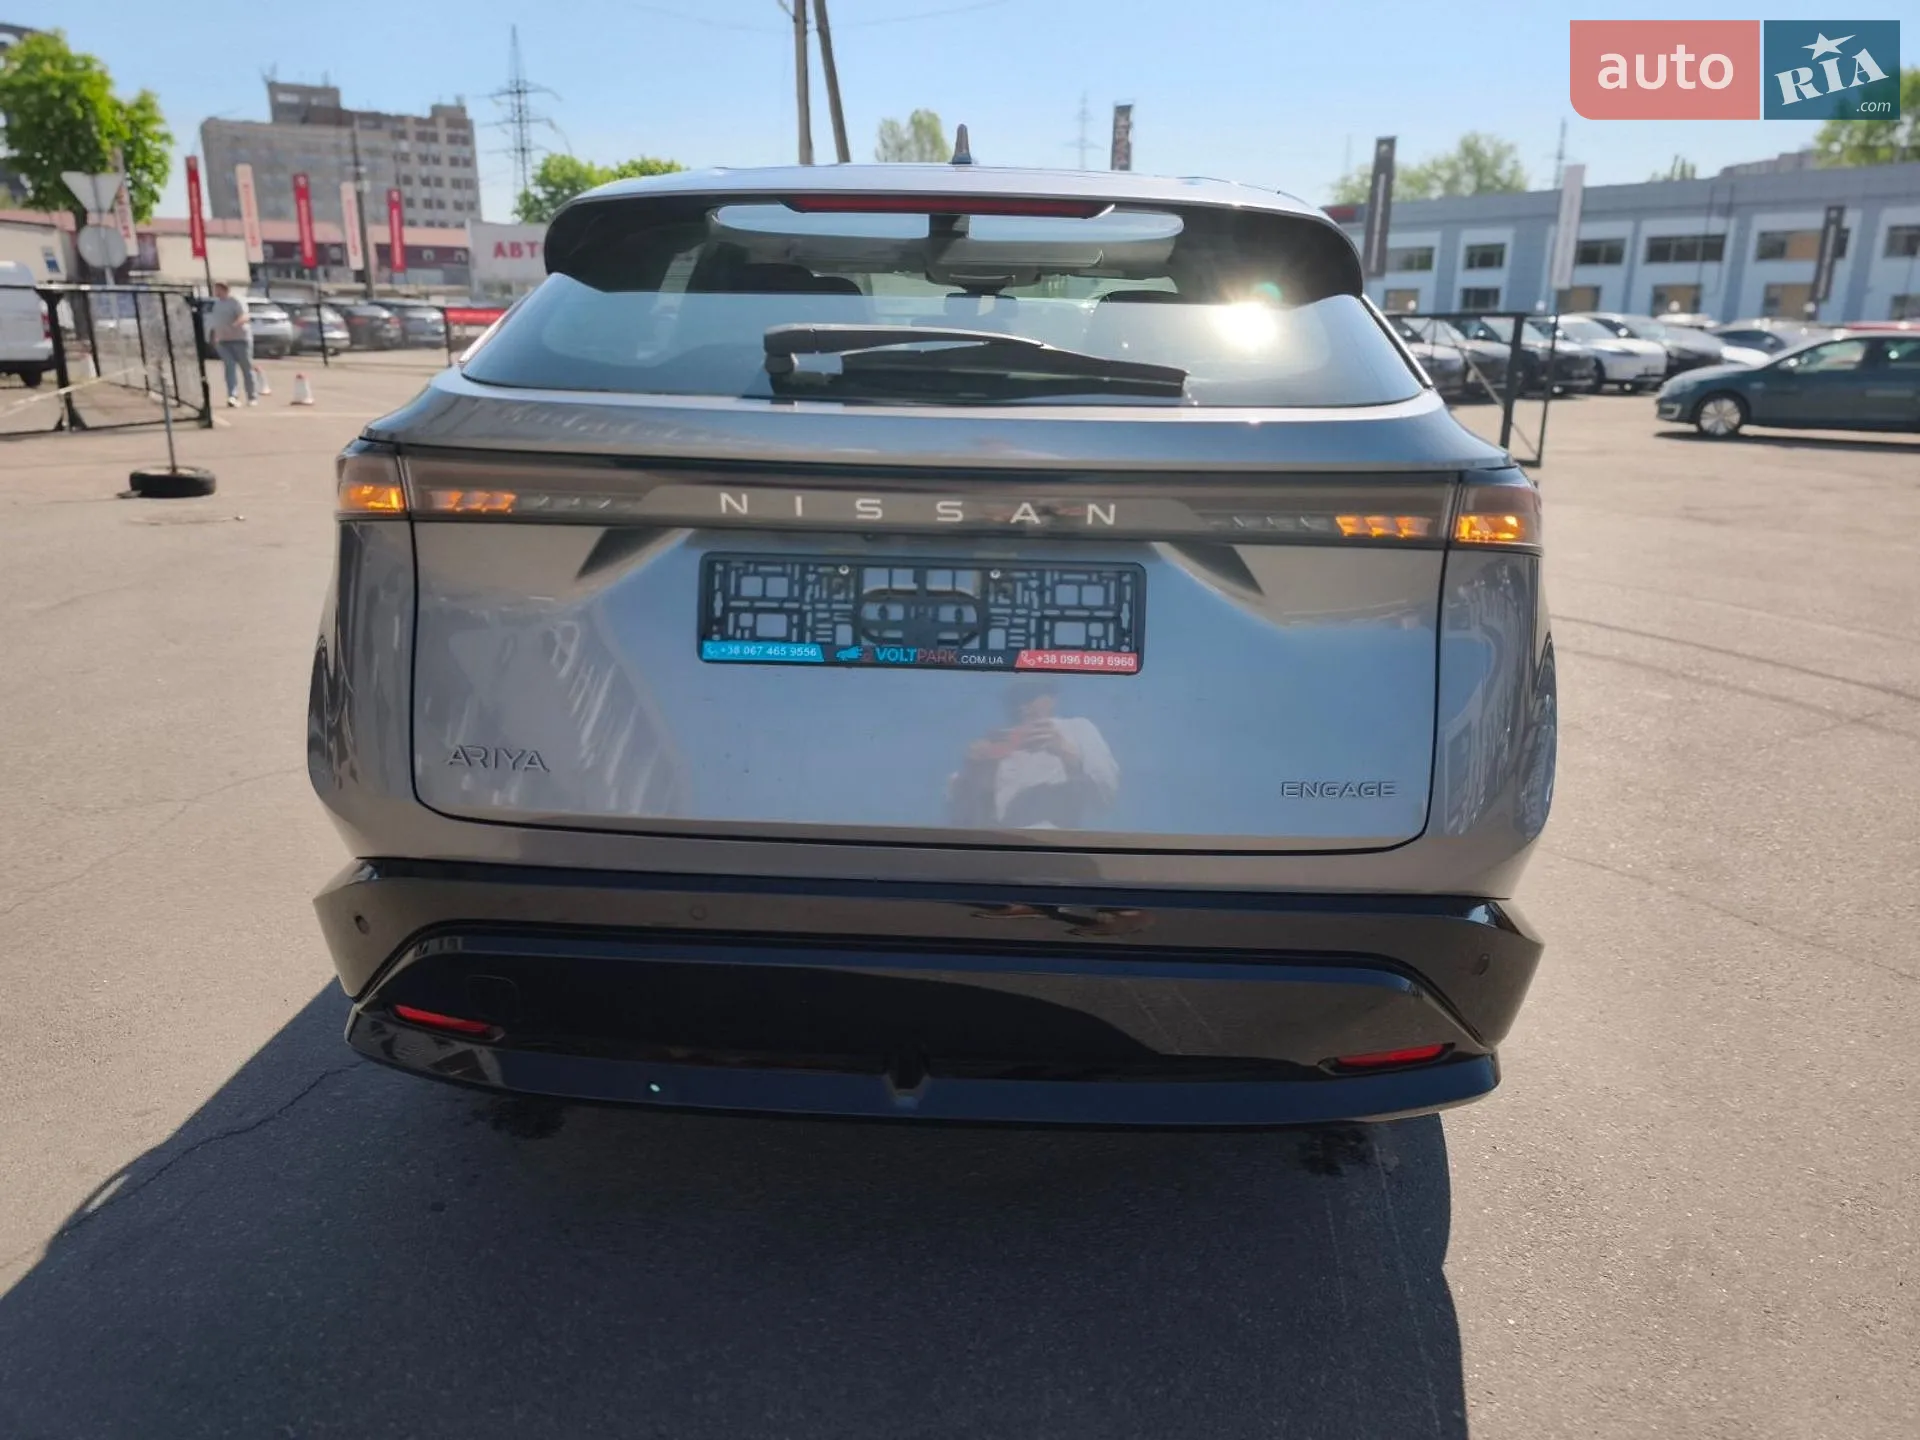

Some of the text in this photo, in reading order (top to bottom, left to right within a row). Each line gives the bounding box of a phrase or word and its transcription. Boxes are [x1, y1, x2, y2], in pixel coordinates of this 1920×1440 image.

[493, 240, 546, 260] АВТ
[719, 491, 1117, 526] NISSAN
[743, 645, 764, 656] 067
[767, 646, 787, 657] 465
[1035, 653, 1057, 665] +38
[448, 744, 551, 773] ARIYA
[1280, 780, 1398, 799] ENGAGE
